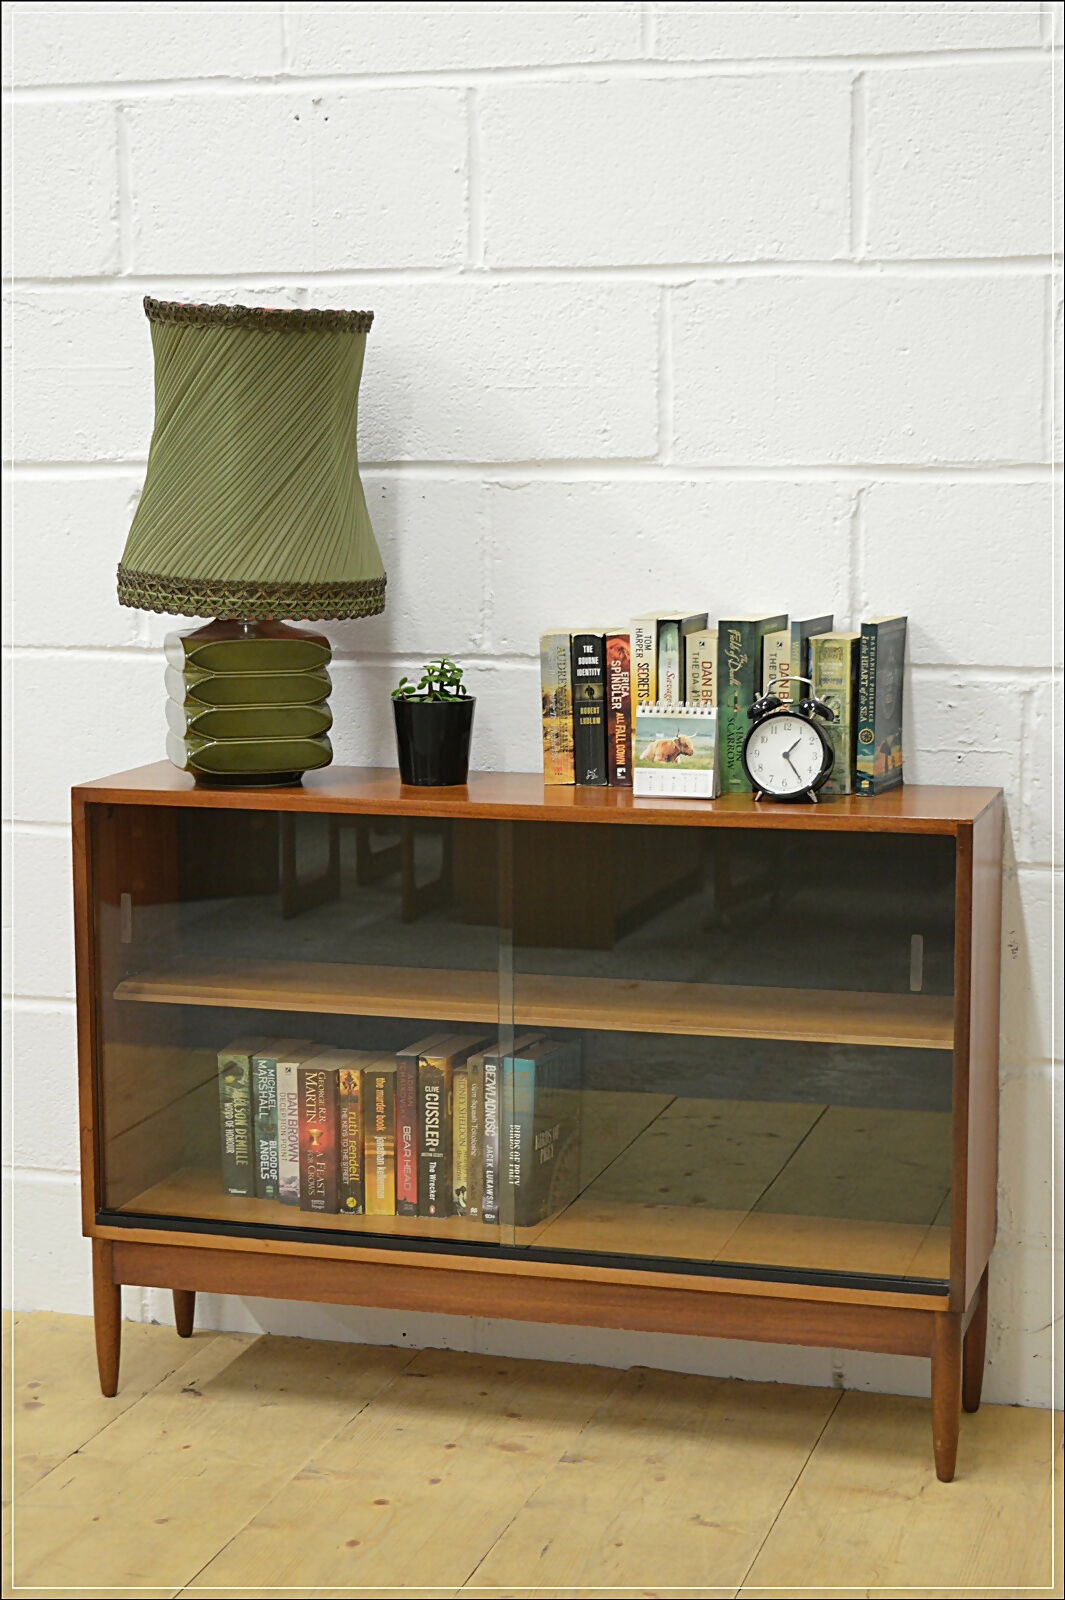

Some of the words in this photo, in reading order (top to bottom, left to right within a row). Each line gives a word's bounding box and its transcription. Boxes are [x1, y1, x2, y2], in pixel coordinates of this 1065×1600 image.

[583, 645, 594, 653] THE
[644, 636, 652, 651] TOM
[557, 647, 567, 689] AUDREY
[578, 657, 599, 665] BOURNE
[692, 652, 700, 670] THE
[769, 654, 777, 671] THE
[861, 656, 869, 686] HEART
[577, 668, 601, 677] IDENTITY
[638, 663, 650, 698] SECRETS
[692, 672, 700, 685] DA
[702, 662, 712, 687] DAN
[779, 663, 790, 688] DAN
[611, 660, 622, 710] SPINDLER
[580, 707, 600, 715] ROBERT
[580, 717, 601, 725] LUDLUM
[616, 712, 624, 729] ALL
[860, 706, 868, 722] SEA
[771, 726, 777, 734] 11
[784, 723, 792, 731] 12
[616, 730, 625, 748] FALL
[736, 726, 744, 762] SIMON
[809, 737, 814, 745] 2
[616, 748, 626, 765] DOWN
[755, 750, 759, 758] 9
[813, 752, 818, 760] 3
[758, 764, 763, 772] 8
[808, 766, 812, 774] 4
[769, 775, 774, 783] 7
[782, 778, 787, 787] 6
[258, 1060, 269, 1119] MARSHALL
[267, 1069, 276, 1110] MICHAEL
[376, 1077, 386, 1088] the
[287, 1092, 297, 1117] DAN
[306, 1072, 318, 1123] MARTIN
[376, 1090, 386, 1114] murder
[226, 1117, 234, 1127] OF
[348, 1112, 359, 1136] ruth
[376, 1115, 386, 1132] book
[425, 1093, 439, 1147] CUSSLER
[459, 1107, 467, 1147] SHELDON
[226, 1128, 234, 1154] HONOUR
[235, 1129, 248, 1166] DEMILLE
[288, 1118, 299, 1163] BROWN
[342, 1139, 349, 1148] TO
[374, 1136, 386, 1165] jonathan
[403, 1126, 412, 1158] BEAR
[260, 1140, 270, 1180] ANGELS
[269, 1140, 278, 1168] BLOOD
[349, 1140, 360, 1181] rendell
[486, 1145, 494, 1168] JACEK
[270, 1168, 278, 1181] OF
[403, 1160, 412, 1192] HEAD
[429, 1162, 437, 1173] The
[307, 1165, 316, 1196] CROWS
[316, 1162, 326, 1197] FEAST
[429, 1174, 437, 1201] Wrecker
